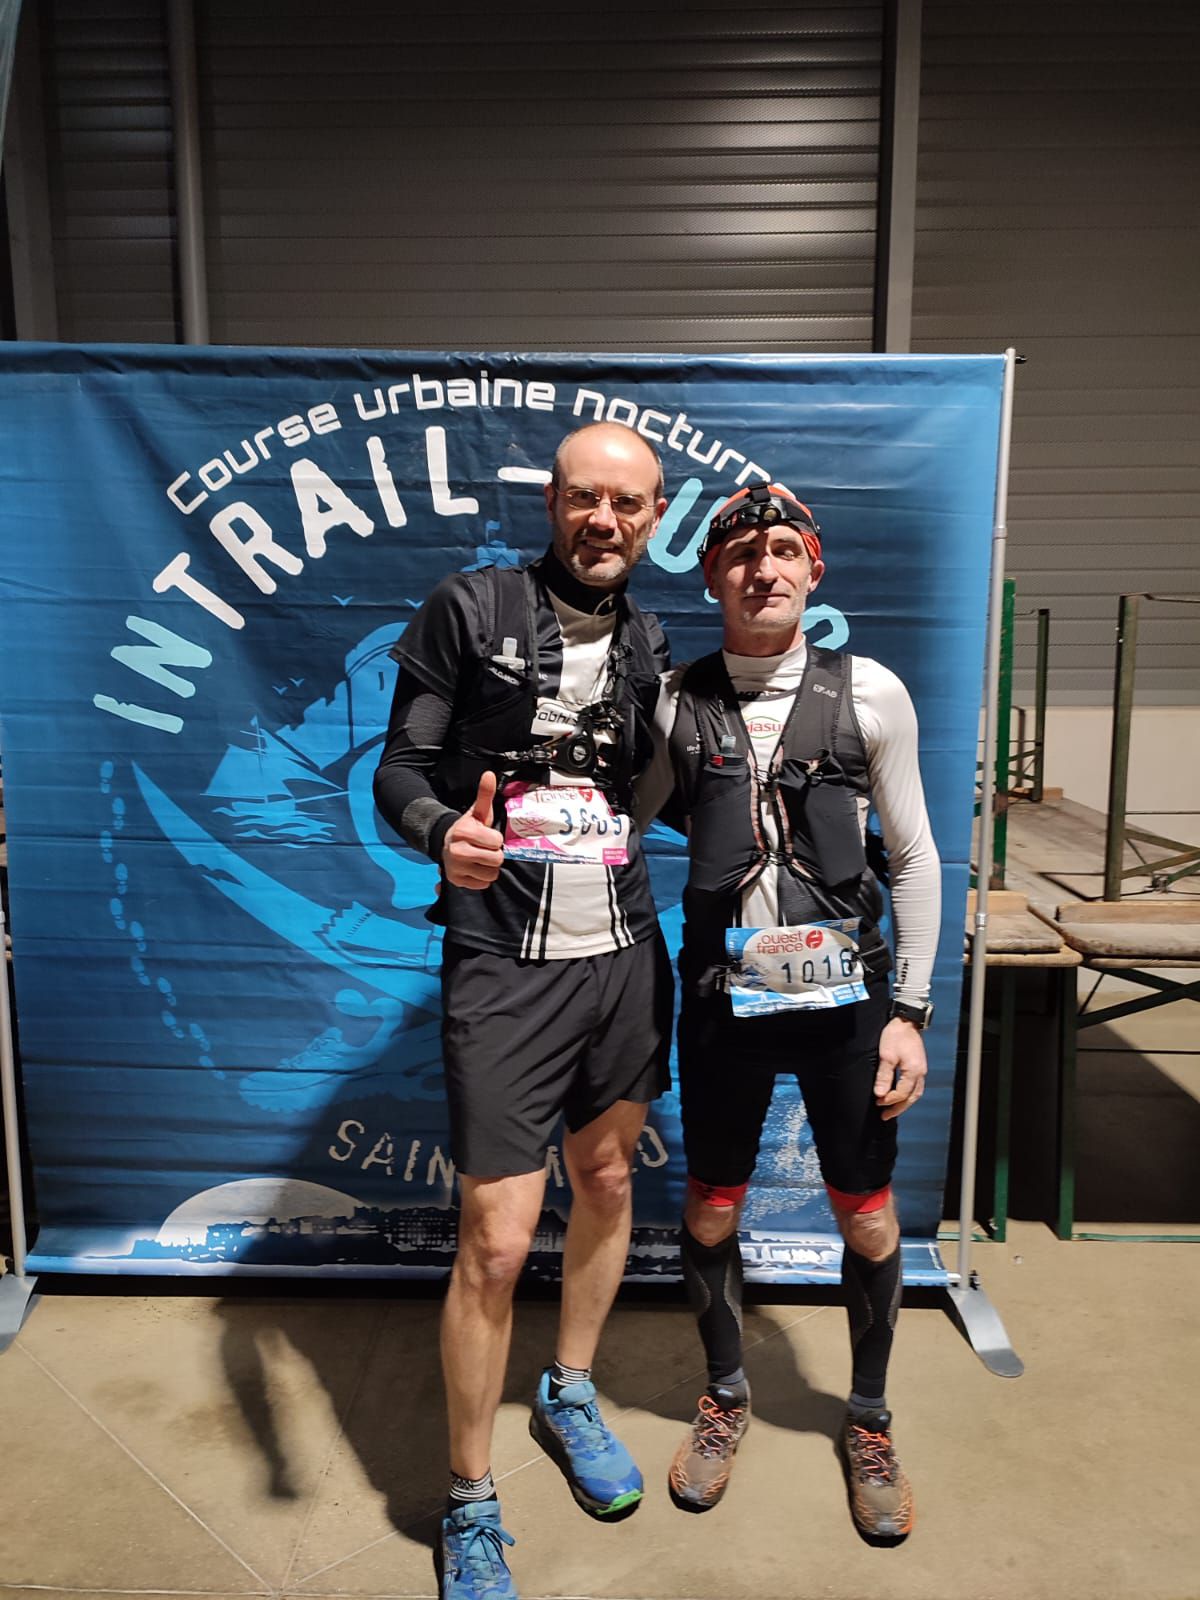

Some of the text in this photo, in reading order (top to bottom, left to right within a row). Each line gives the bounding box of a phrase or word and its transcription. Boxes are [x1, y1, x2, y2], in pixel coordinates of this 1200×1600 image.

[166, 370, 796, 515] course urbaine nocturn
[757, 942, 804, 955] france
[761, 930, 803, 944] ouest
[781, 947, 853, 984] 1016
